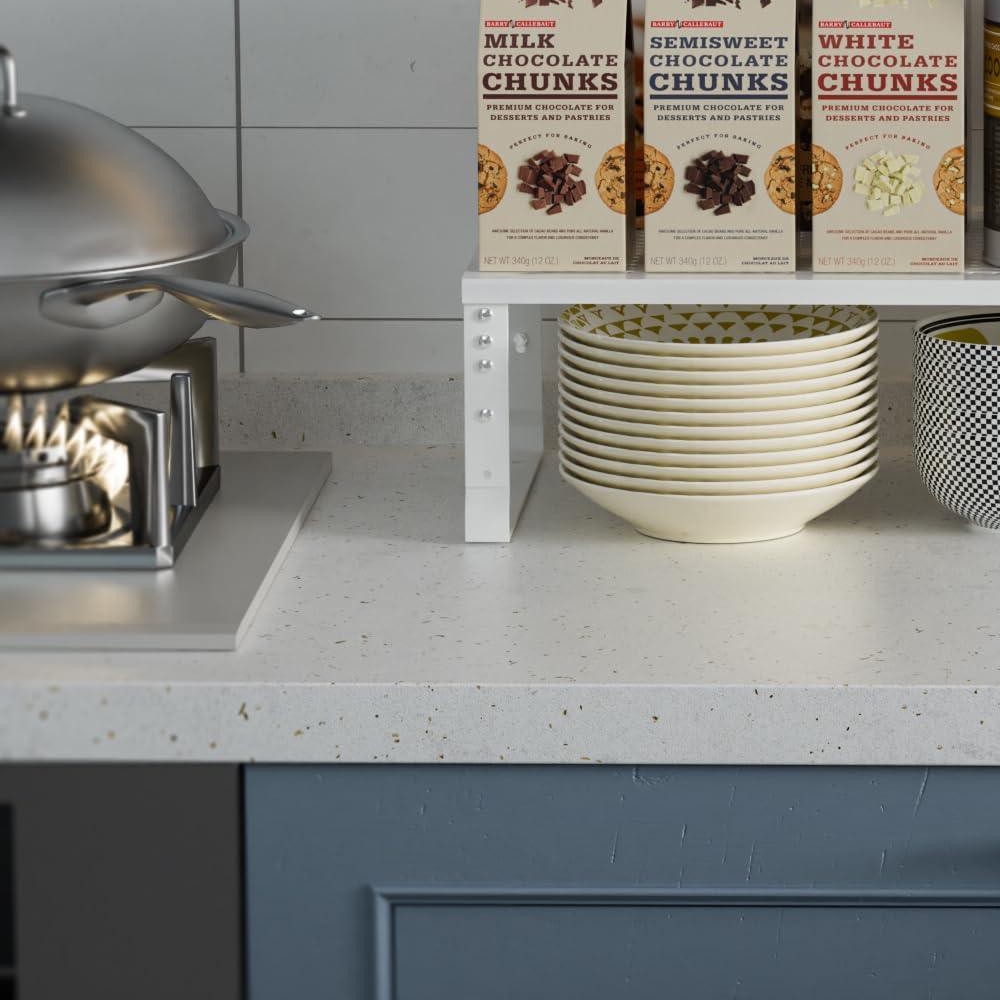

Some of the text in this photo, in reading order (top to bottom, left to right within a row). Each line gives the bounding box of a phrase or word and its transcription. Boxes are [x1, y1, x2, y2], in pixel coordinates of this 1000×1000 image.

[484, 33, 555, 49] MILK
[650, 37, 788, 49] SEMISWEET
[818, 34, 914, 49] WHITE
[483, 54, 618, 67] CHOCOLATE
[650, 55, 788, 67] CHOCOLATE
[818, 55, 958, 67] CHOCOLATE
[482, 73, 618, 91] CHUNKS
[649, 73, 789, 91] CHUNKS
[817, 73, 958, 92] CHUNKS
[509, 133, 542, 150] PERFECT
[564, 134, 593, 149] BAKING
[677, 134, 710, 150] PERFECT
[732, 134, 762, 149] BAKING
[845, 134, 879, 150] PERFECT
[901, 135, 931, 149] BAKING
[483, 256, 498, 265] NET
[499, 256, 510, 265] WT
[650, 256, 664, 265] NET
[666, 256, 677, 265] WT
[818, 256, 832, 266] NET
[834, 256, 844, 266] WT
